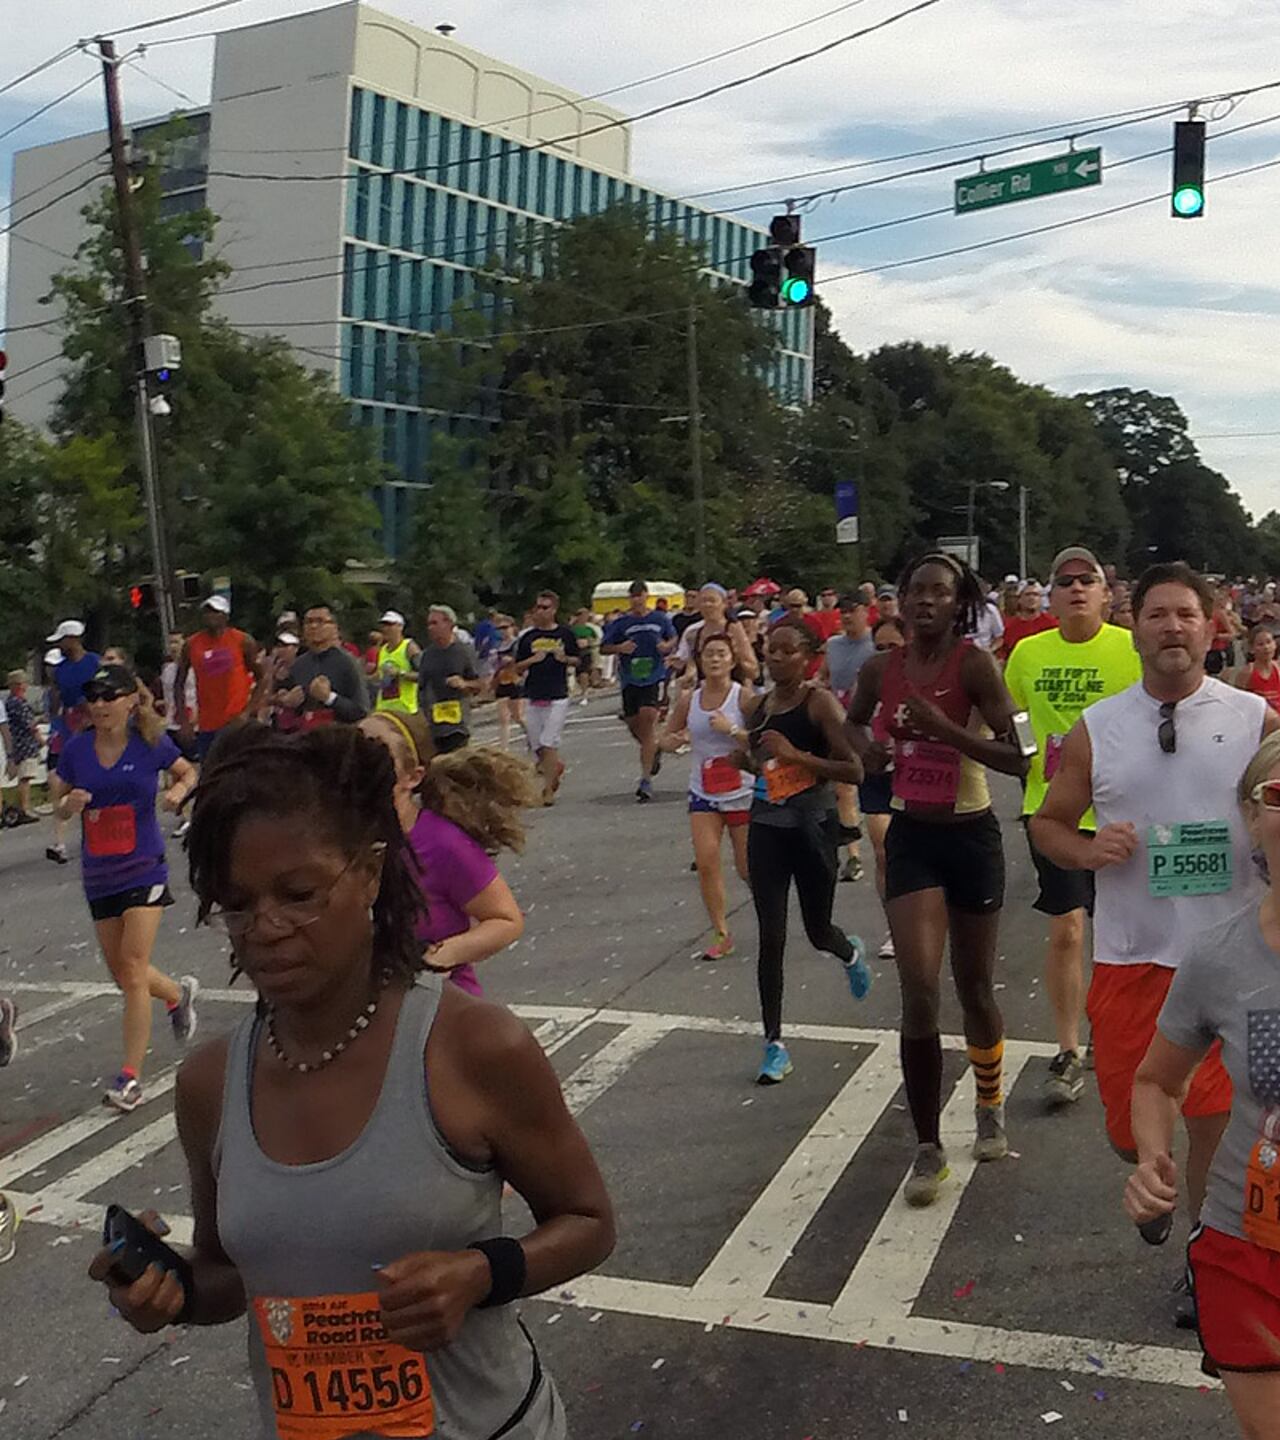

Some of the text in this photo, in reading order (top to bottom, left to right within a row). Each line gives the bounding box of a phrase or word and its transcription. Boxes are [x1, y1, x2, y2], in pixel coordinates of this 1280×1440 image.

[1011, 173, 1032, 194] Rd
[1034, 680, 1104, 693] START LNE
[1153, 852, 1227, 876] P 55681
[1250, 1183, 1264, 1214] D
[303, 1310, 382, 1328] Peachtr
[307, 1327, 390, 1344] Road Ra
[272, 1360, 424, 1413] D 14556
